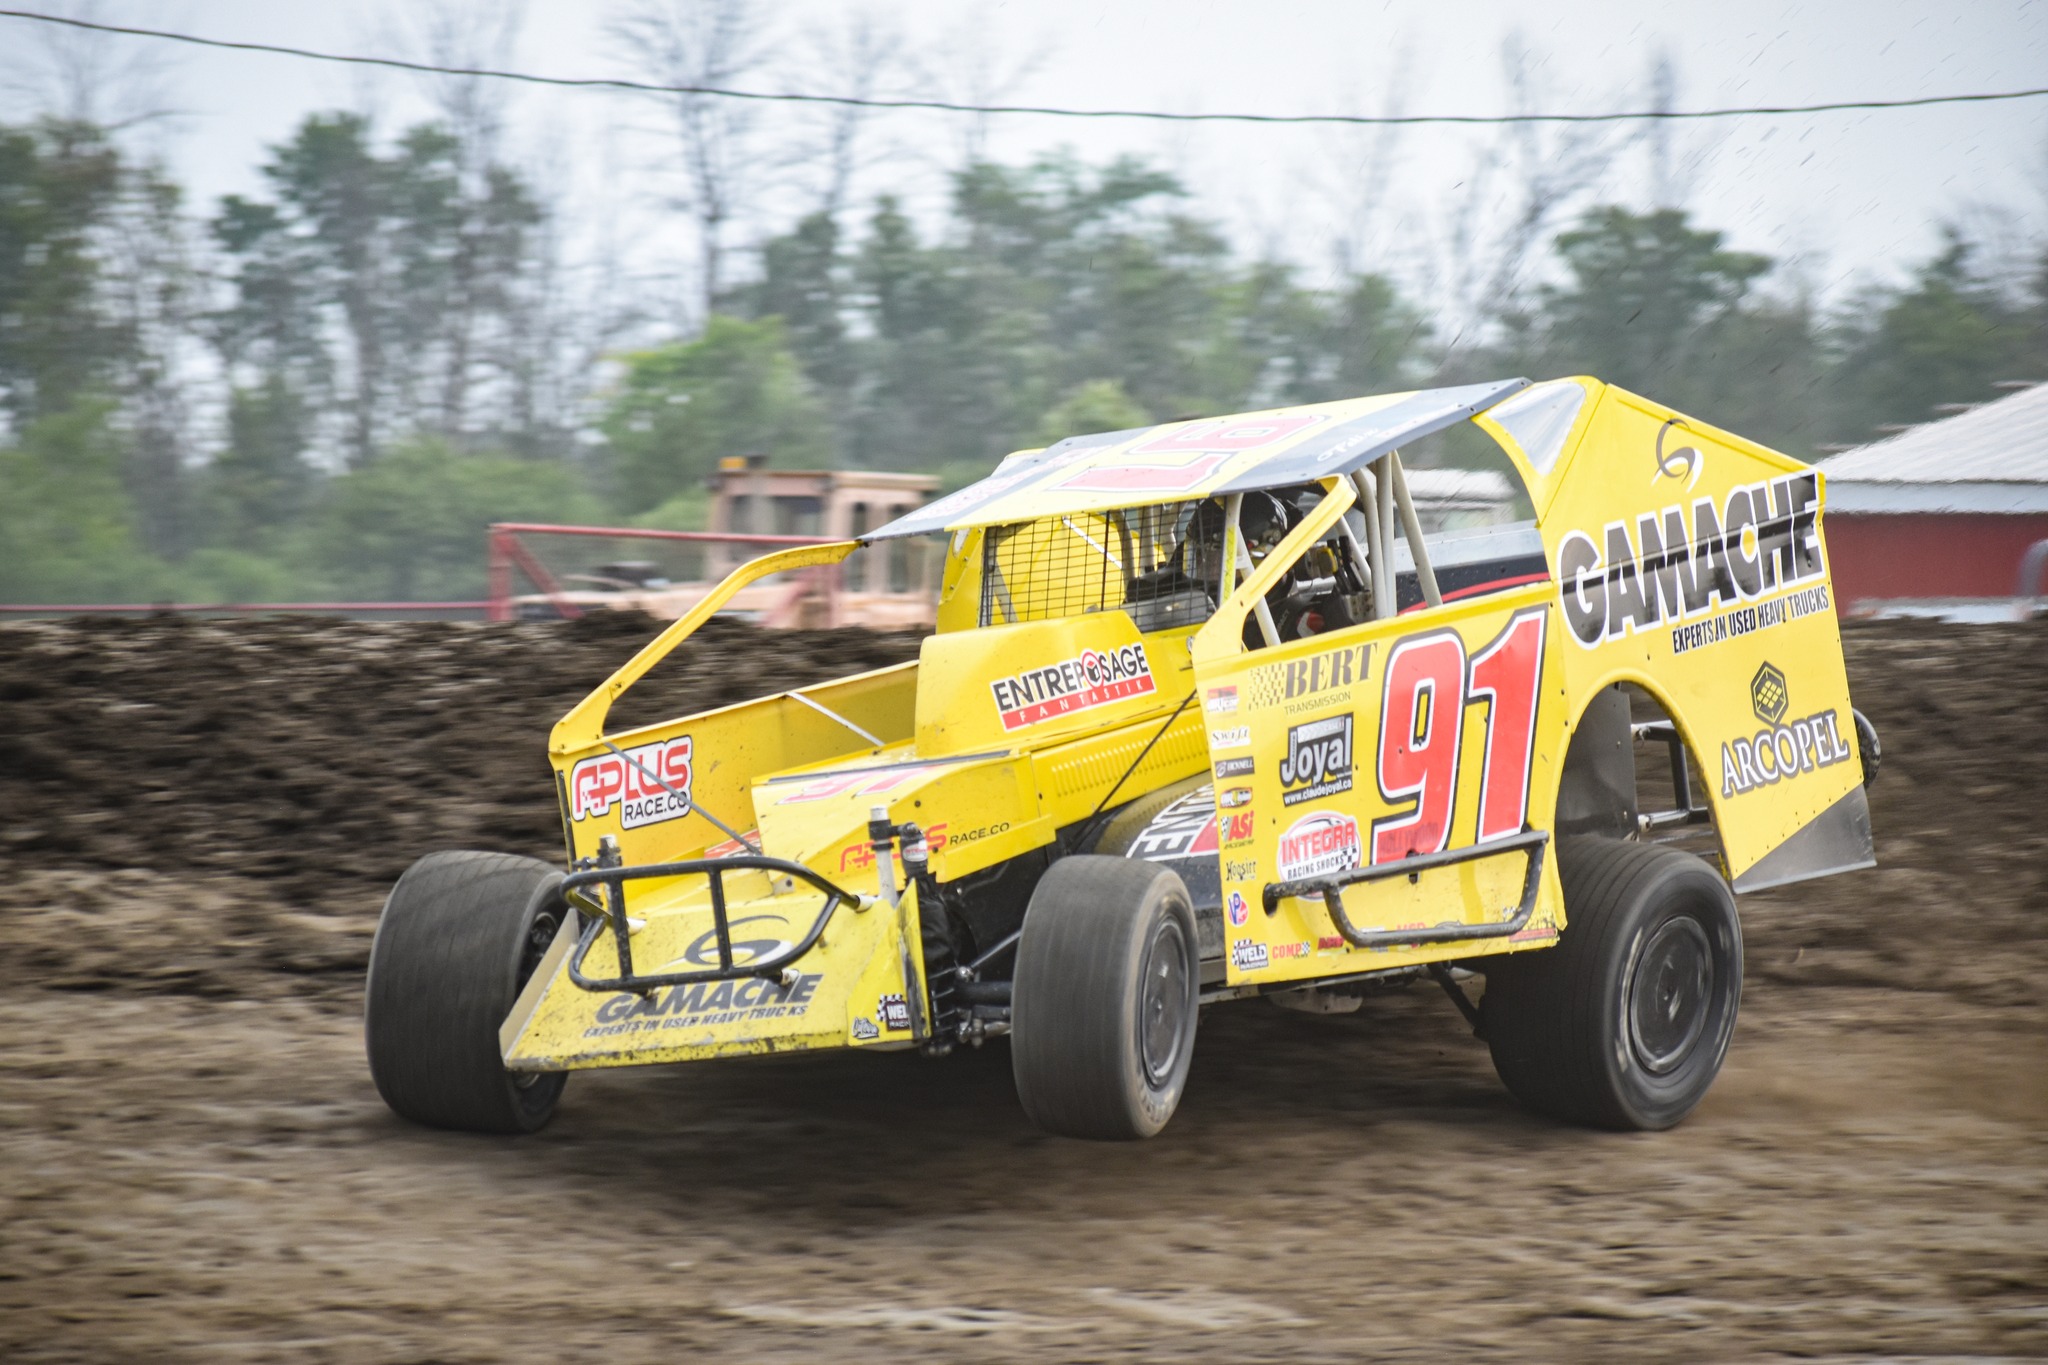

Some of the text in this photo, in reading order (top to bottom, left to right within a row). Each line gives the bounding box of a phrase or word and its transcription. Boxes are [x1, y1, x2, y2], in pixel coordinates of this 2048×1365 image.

[1557, 469, 1826, 650] GAMACHE
[1672, 585, 1829, 654] EXPERTS IN USED HEAVY TRUCKS
[993, 645, 1149, 713] ENTREPOSAGE
[1285, 642, 1378, 700] BERT
[1019, 679, 1144, 723] FANTASTIK
[1284, 692, 1351, 715] TRANSMISSION
[1281, 716, 1352, 785] Joyal
[1371, 603, 1549, 866] 91
[1722, 710, 1850, 798] ARCOPEL
[624, 791, 688, 822] RACE.CO
[1284, 779, 1352, 805] www.claudejoyal.ca
[949, 822, 1010, 846] RACE.CO
[1281, 821, 1356, 867] INTEGRA
[1287, 853, 1344, 881] RACING SHOCKS
[1238, 943, 1267, 965] WELD
[1272, 943, 1302, 959] COMP
[595, 974, 824, 1025] GAMACHE
[583, 1020, 640, 1038] EXPERTS
[644, 1018, 659, 1032] IN
[701, 1010, 747, 1025] HEAVY
